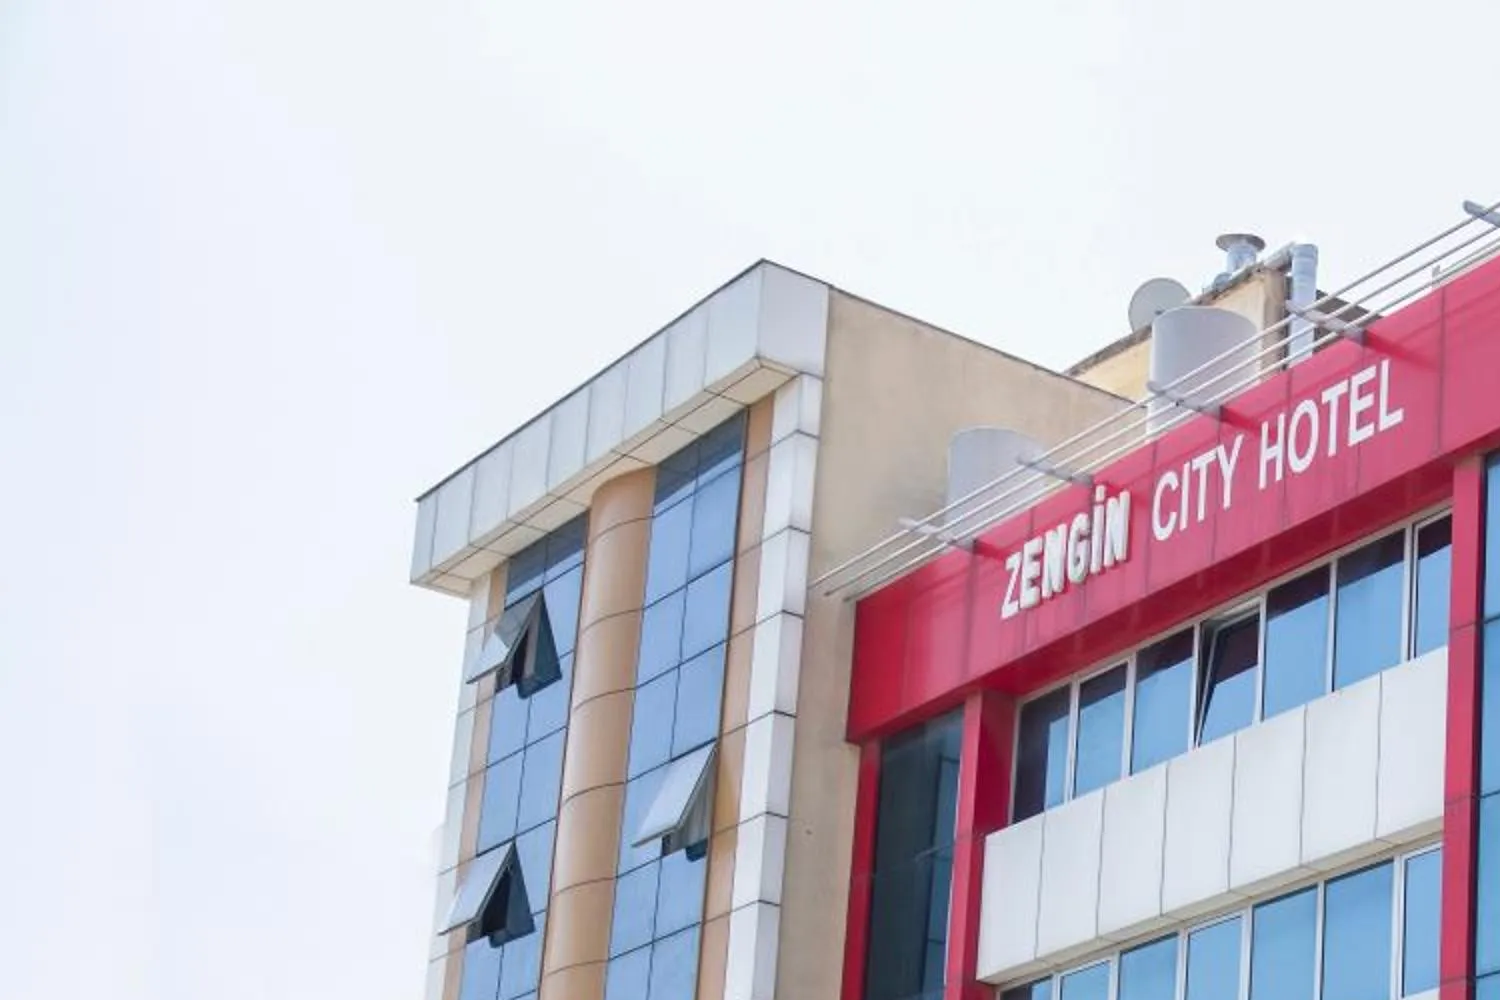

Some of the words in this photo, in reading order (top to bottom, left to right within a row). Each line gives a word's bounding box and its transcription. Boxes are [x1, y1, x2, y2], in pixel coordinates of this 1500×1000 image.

[1002, 484, 1132, 619] ZENGİN
[1151, 434, 1244, 541] CITY
[1258, 359, 1404, 490] HOTEL
